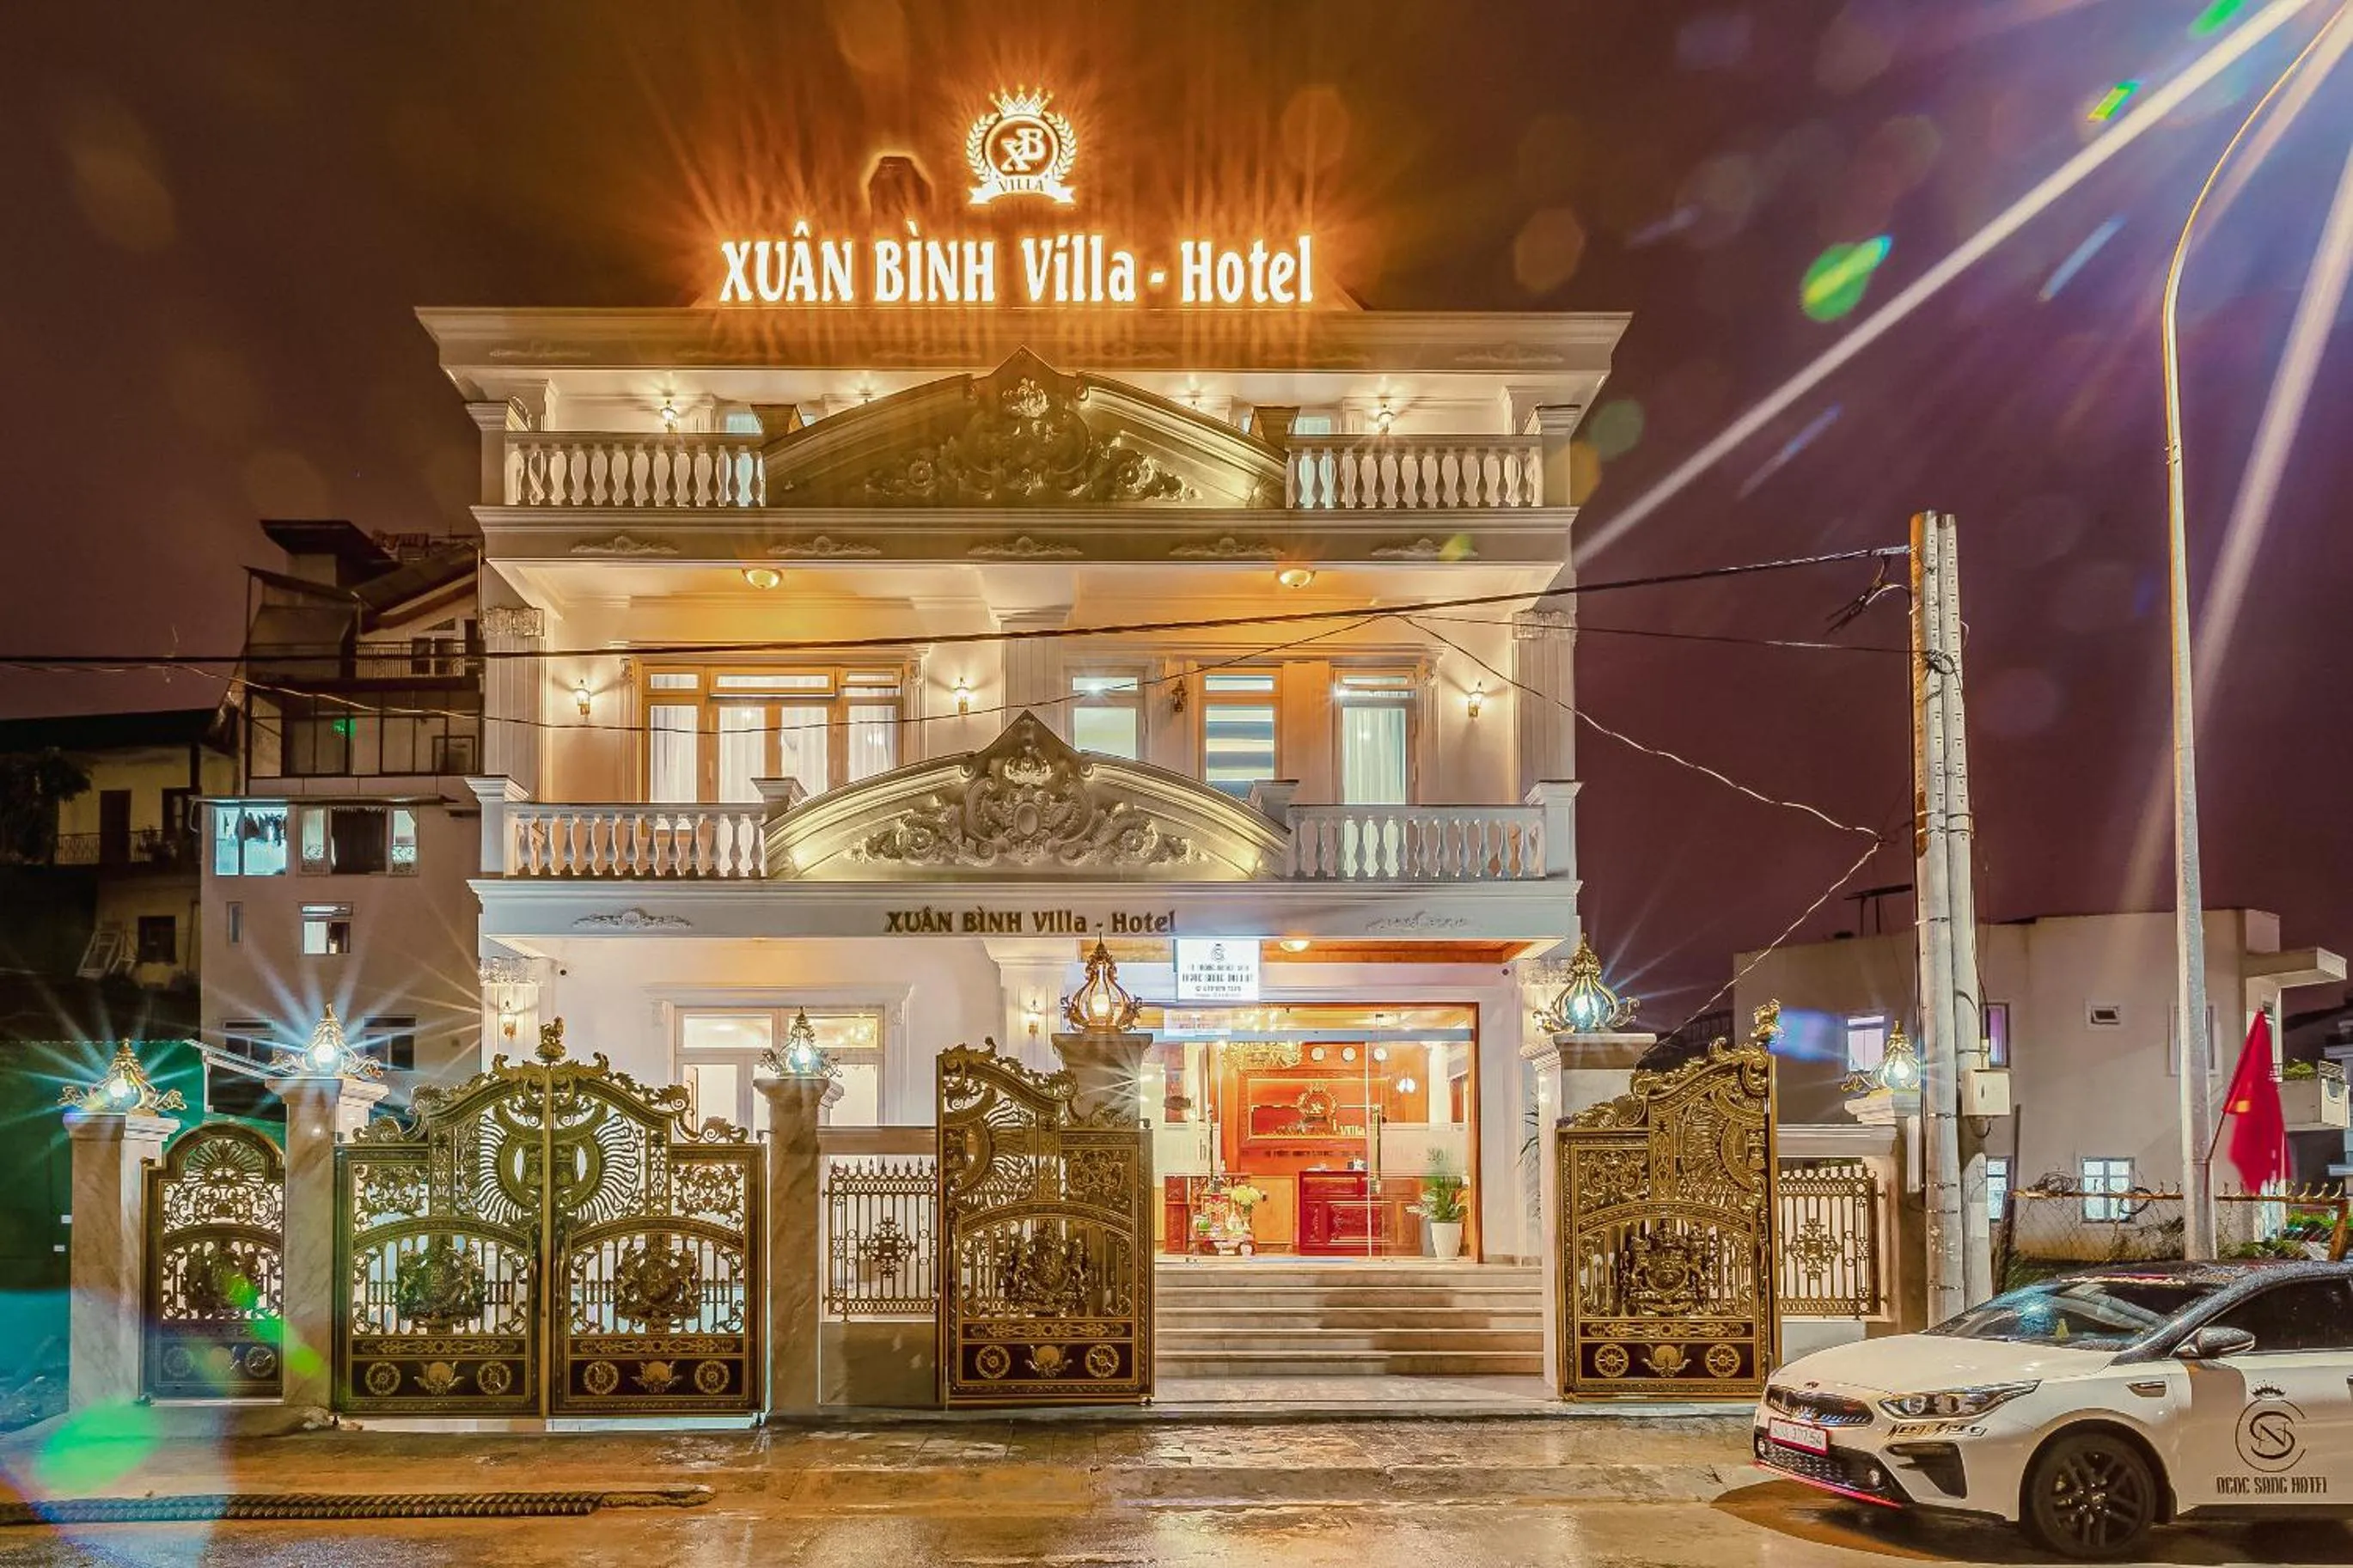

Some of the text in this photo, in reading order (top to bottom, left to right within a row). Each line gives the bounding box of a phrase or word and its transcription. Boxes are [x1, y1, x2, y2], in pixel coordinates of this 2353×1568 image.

[998, 177, 1044, 192] VILLA
[719, 219, 1313, 303] XUÂN BÌNH Villa - Hotel
[884, 905, 954, 933] XUÂN
[962, 905, 1023, 933] BÌNH
[1032, 909, 1087, 933] Villa
[1111, 909, 1176, 934] Hotel
